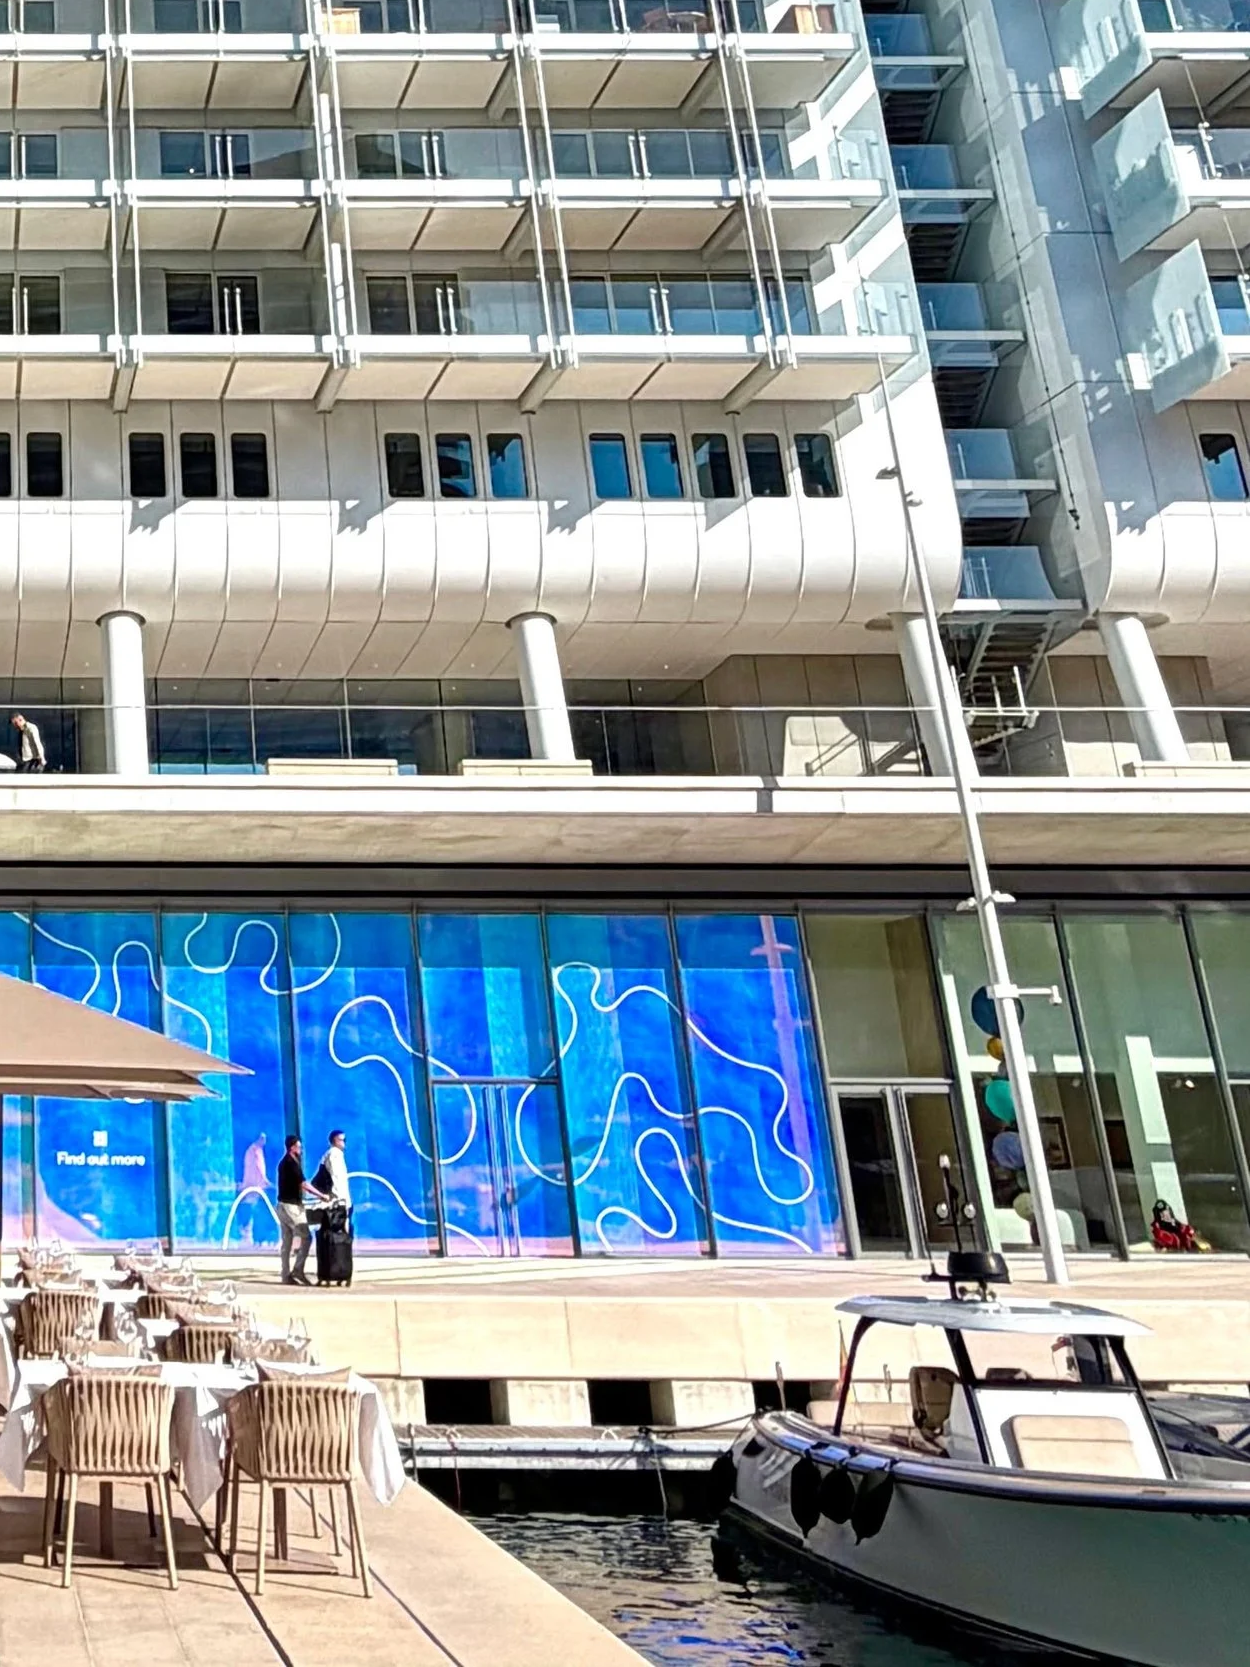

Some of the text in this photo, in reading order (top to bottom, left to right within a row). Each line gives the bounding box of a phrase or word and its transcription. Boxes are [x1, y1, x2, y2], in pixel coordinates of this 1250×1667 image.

[57, 1151, 146, 1166] Find out more
